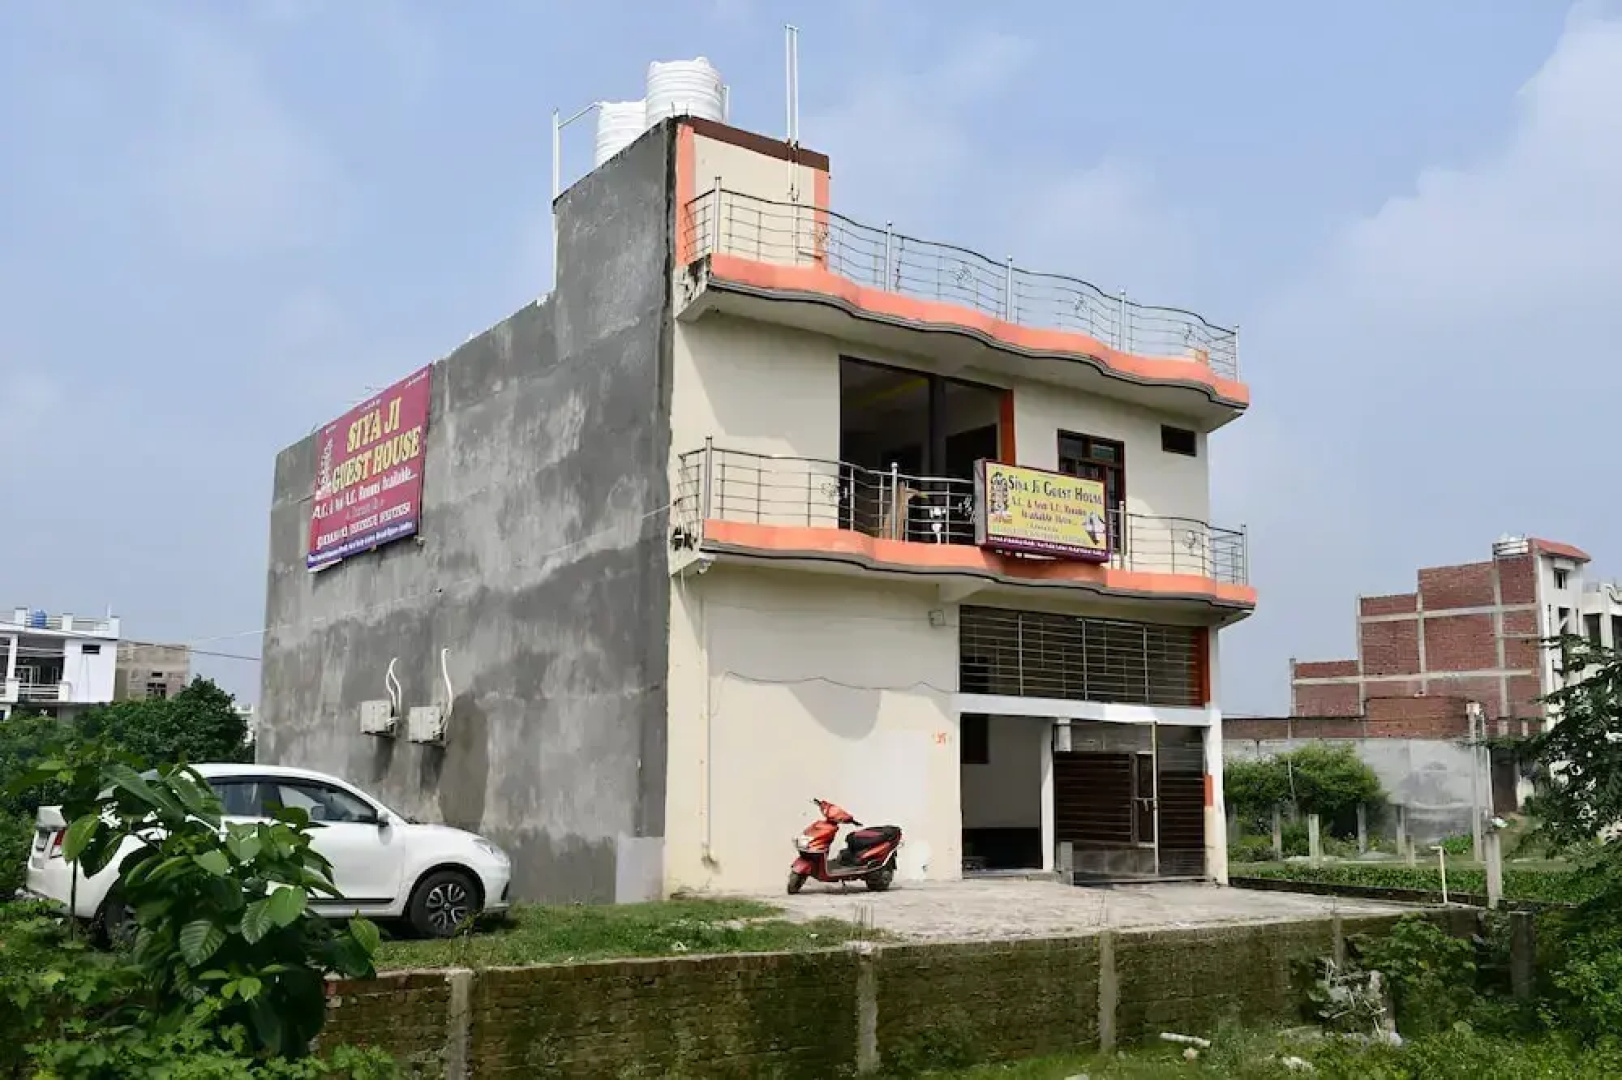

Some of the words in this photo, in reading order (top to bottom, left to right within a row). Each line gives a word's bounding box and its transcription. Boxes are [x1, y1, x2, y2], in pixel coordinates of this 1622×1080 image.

[347, 409, 381, 453] SIYA
[384, 397, 401, 434] JI
[332, 449, 373, 494] GUEST
[373, 425, 421, 475] HOUSE
